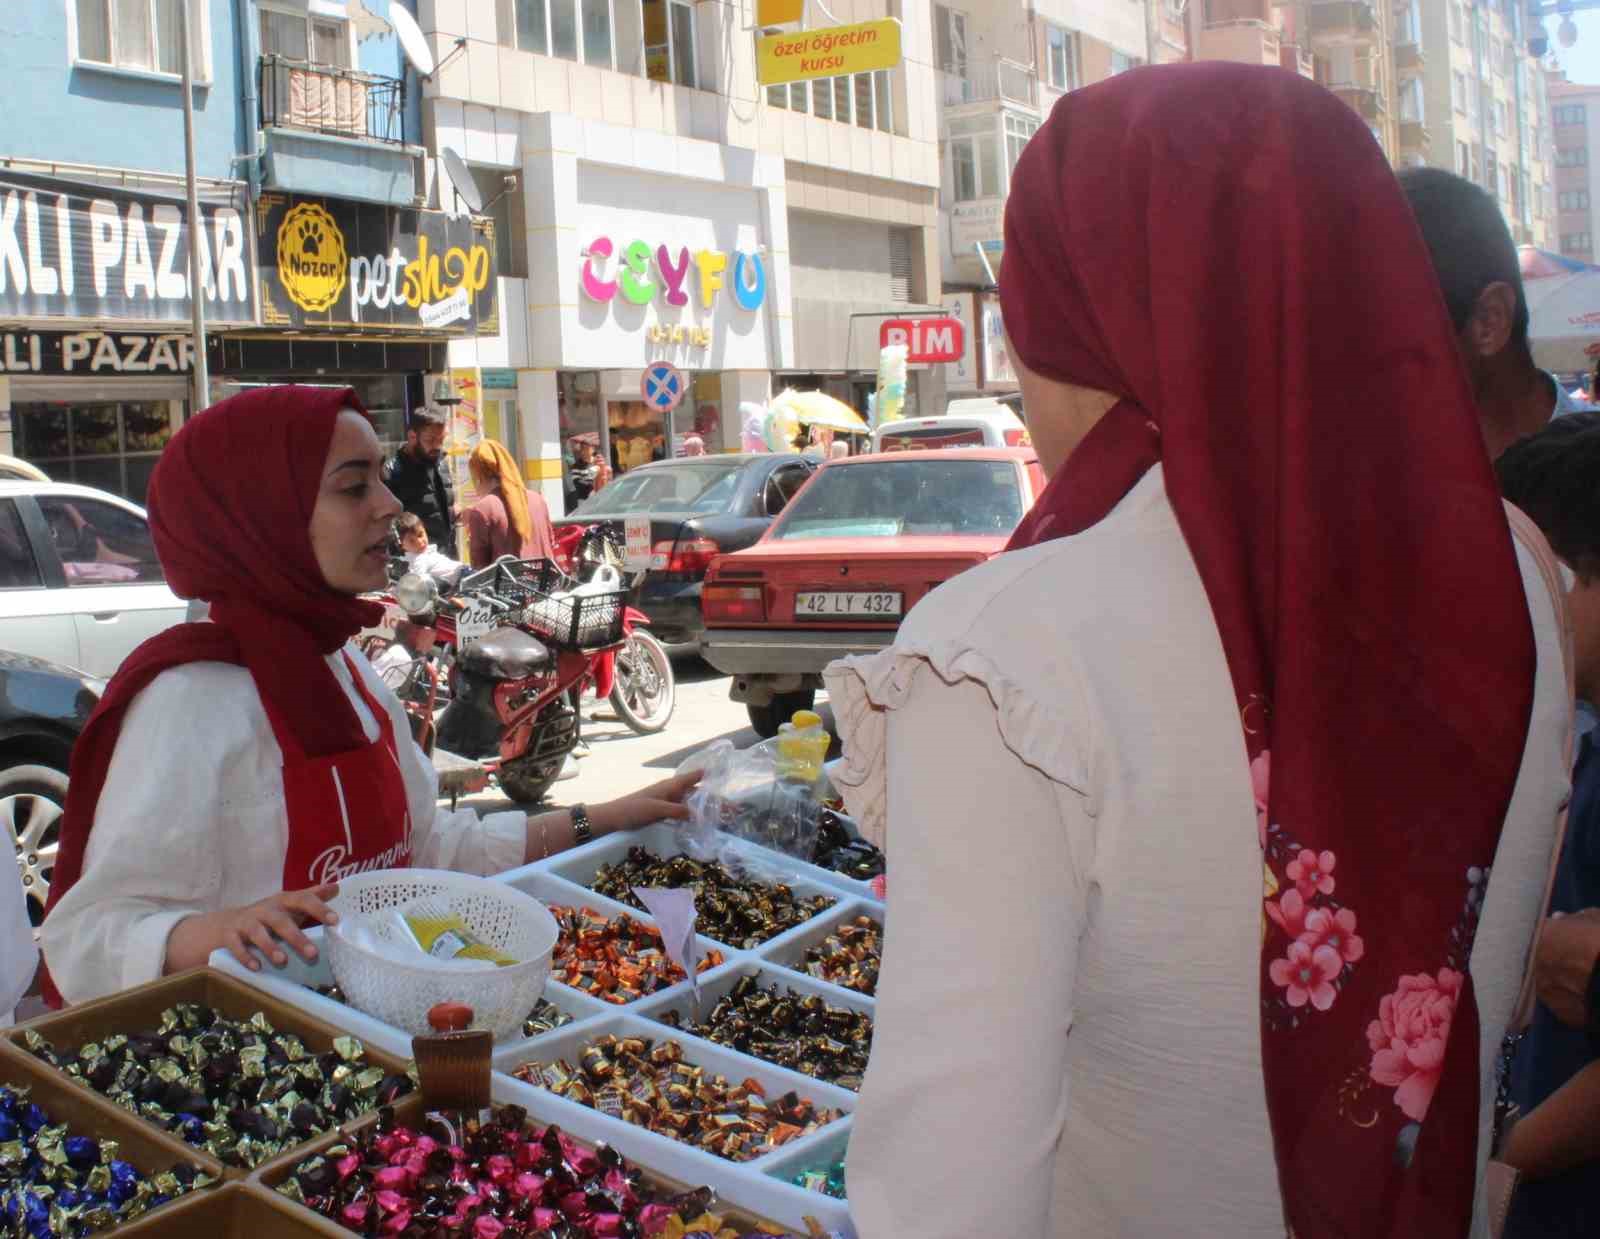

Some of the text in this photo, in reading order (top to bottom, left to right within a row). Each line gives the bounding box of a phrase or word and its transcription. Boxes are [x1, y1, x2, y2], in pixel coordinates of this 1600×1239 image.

[774, 28, 878, 57] özel öğretim
[800, 55, 845, 72] kursu
[89, 199, 247, 302] PAZAR
[290, 255, 337, 278] Nazar
[807, 594, 893, 612] 42 LY 432
